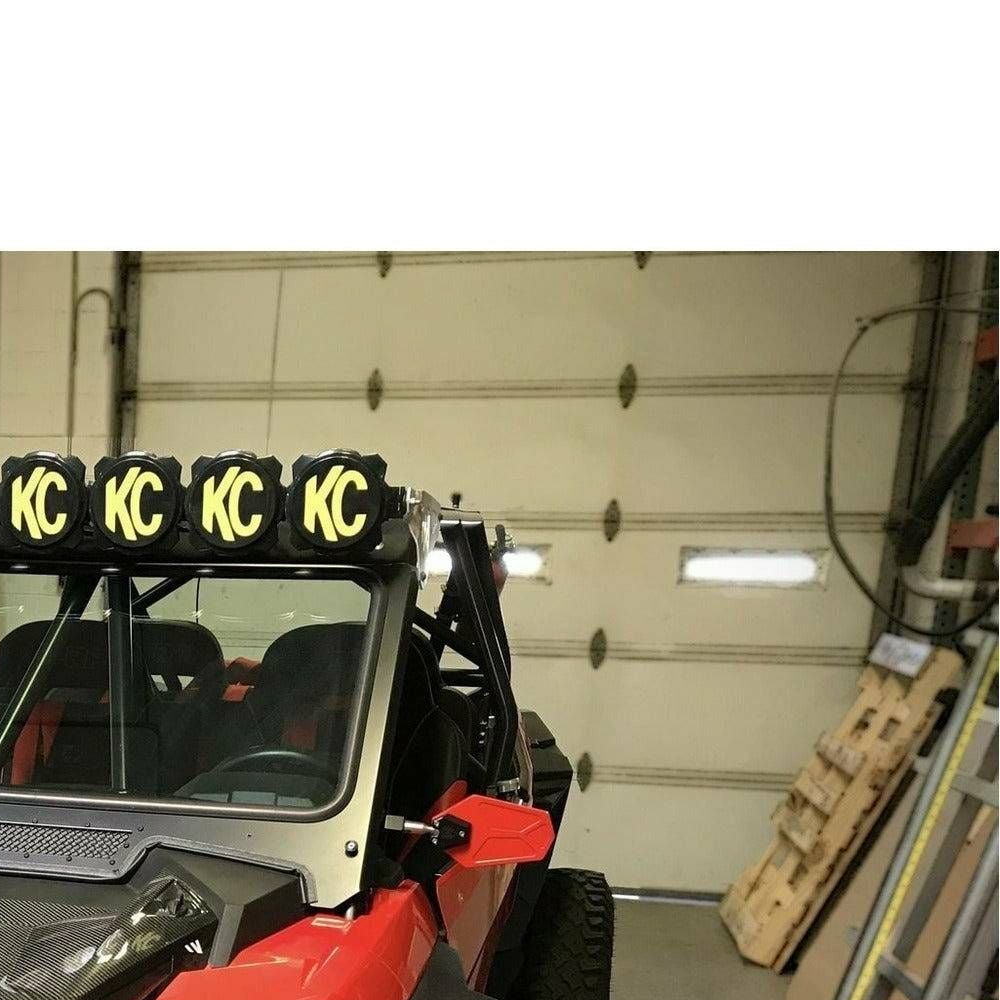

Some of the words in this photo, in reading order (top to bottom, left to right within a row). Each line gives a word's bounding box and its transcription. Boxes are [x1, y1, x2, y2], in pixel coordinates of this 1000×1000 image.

[12, 466, 66, 539] KC
[105, 466, 163, 541] KC
[202, 466, 263, 541] KC
[303, 465, 368, 542] KC
